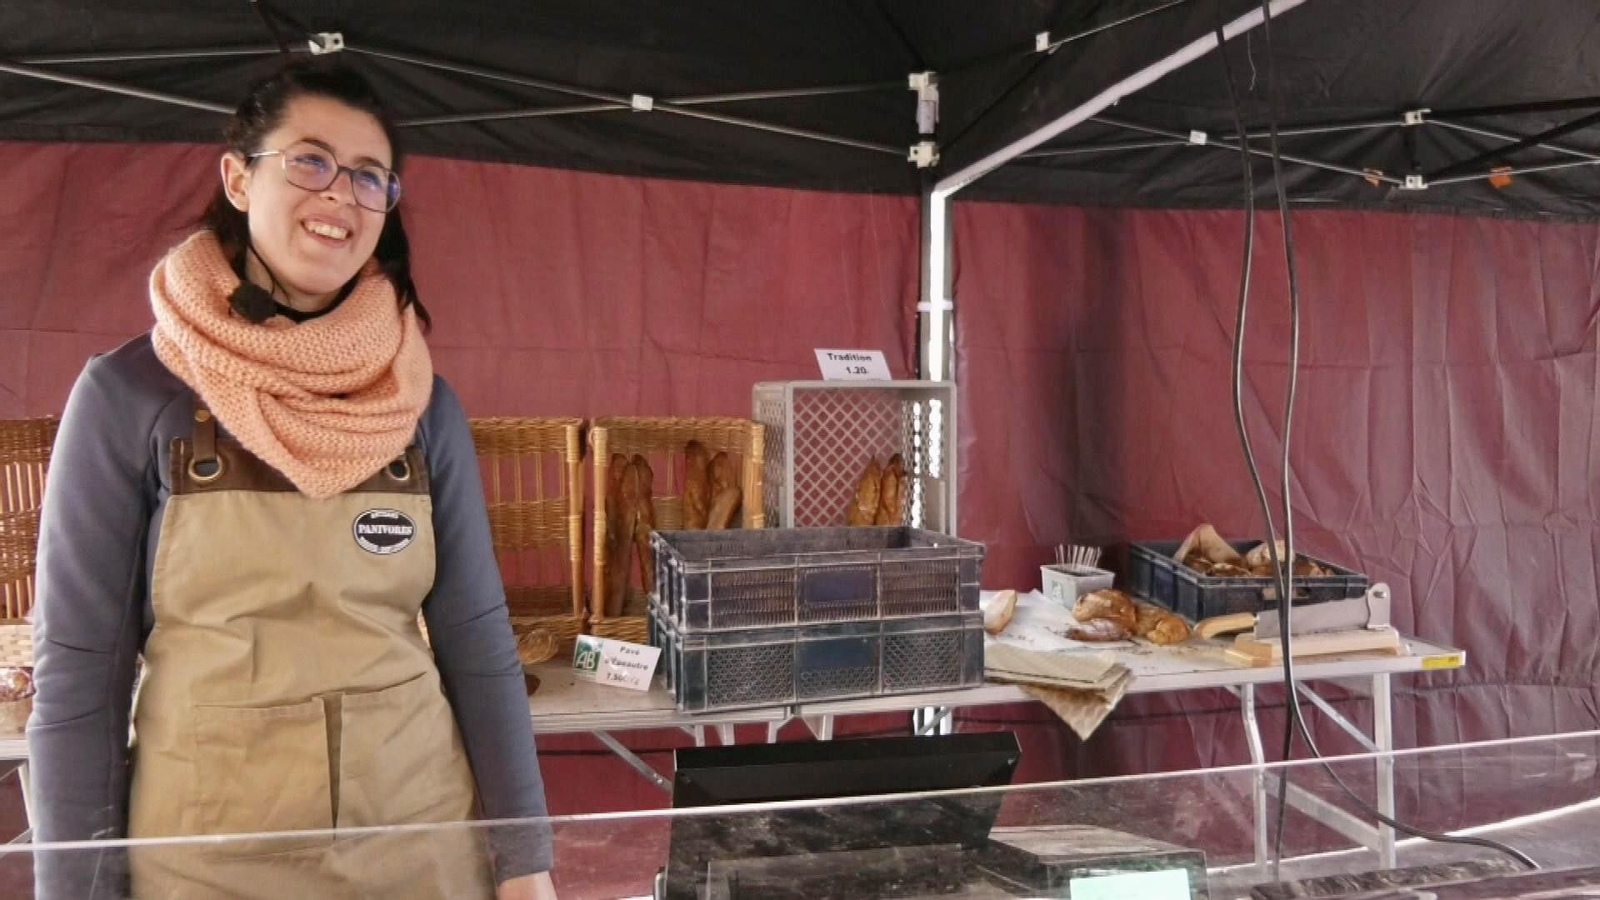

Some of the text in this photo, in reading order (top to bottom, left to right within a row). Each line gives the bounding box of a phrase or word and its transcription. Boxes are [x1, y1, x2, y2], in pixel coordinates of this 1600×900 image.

[827, 352, 872, 362] Tradition
[358, 524, 413, 535] PANIVORES
[575, 651, 596, 670] AB
